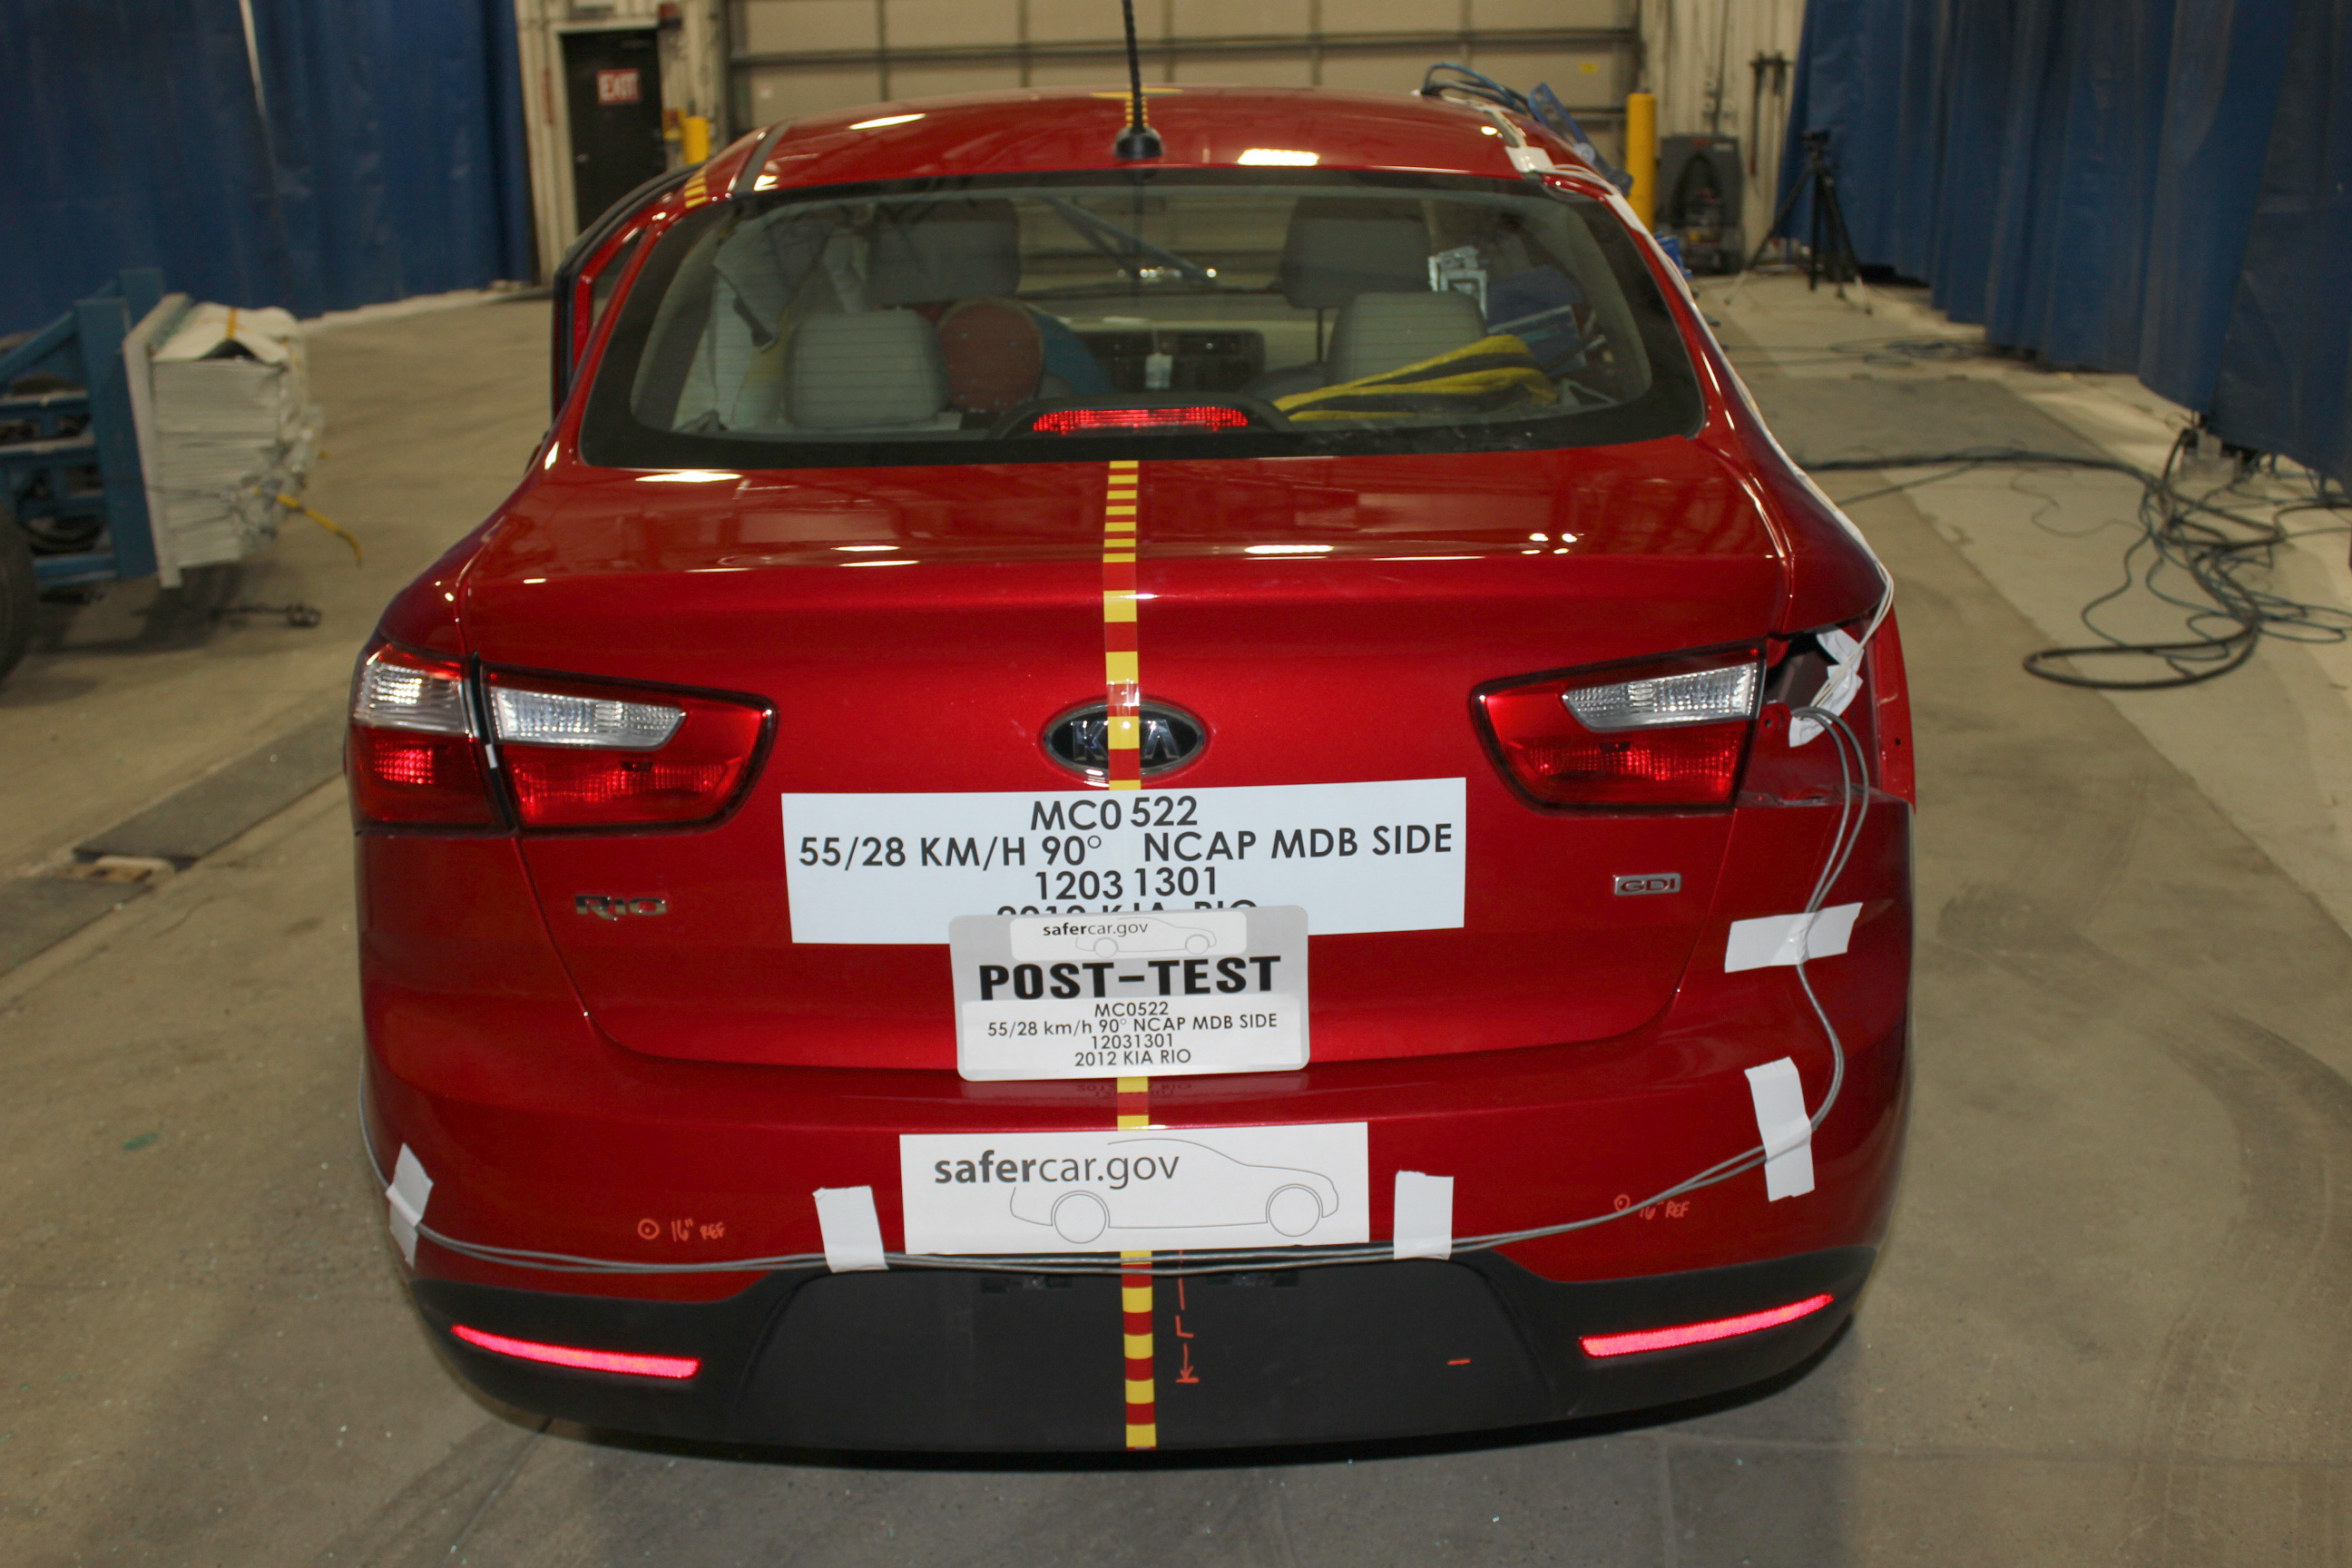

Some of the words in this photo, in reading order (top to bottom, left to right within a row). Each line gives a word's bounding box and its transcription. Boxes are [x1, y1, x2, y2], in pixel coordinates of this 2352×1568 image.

[599, 73, 638, 100] EXIT
[1072, 719, 1181, 760] KA
[799, 836, 906, 871] 55/28
[920, 836, 1025, 871] KM/H
[1042, 835, 1102, 867] 90°
[1144, 830, 1257, 862] NCAP
[1270, 827, 1358, 859] MDB
[1372, 823, 1452, 856] SIDE
[1621, 878, 1676, 892] GDI
[1043, 921, 1149, 937] safercar.gov
[978, 956, 1281, 1002] POST-TEST
[1094, 1001, 1169, 1017] MC0522
[987, 1021, 1038, 1038] 55/28
[1044, 1019, 1093, 1037] km/h
[1098, 1017, 1128, 1034] 90°
[1133, 1016, 1186, 1033] NCAP
[1192, 1015, 1234, 1031] MDB
[1240, 1014, 1278, 1029] SIDE
[1092, 1033, 1173, 1050] 12031301
[1074, 1051, 1117, 1067] 2012
[1123, 1050, 1153, 1065] KIA
[1161, 1048, 1191, 1064] RIO
[934, 1148, 1181, 1191] safercar.gov
